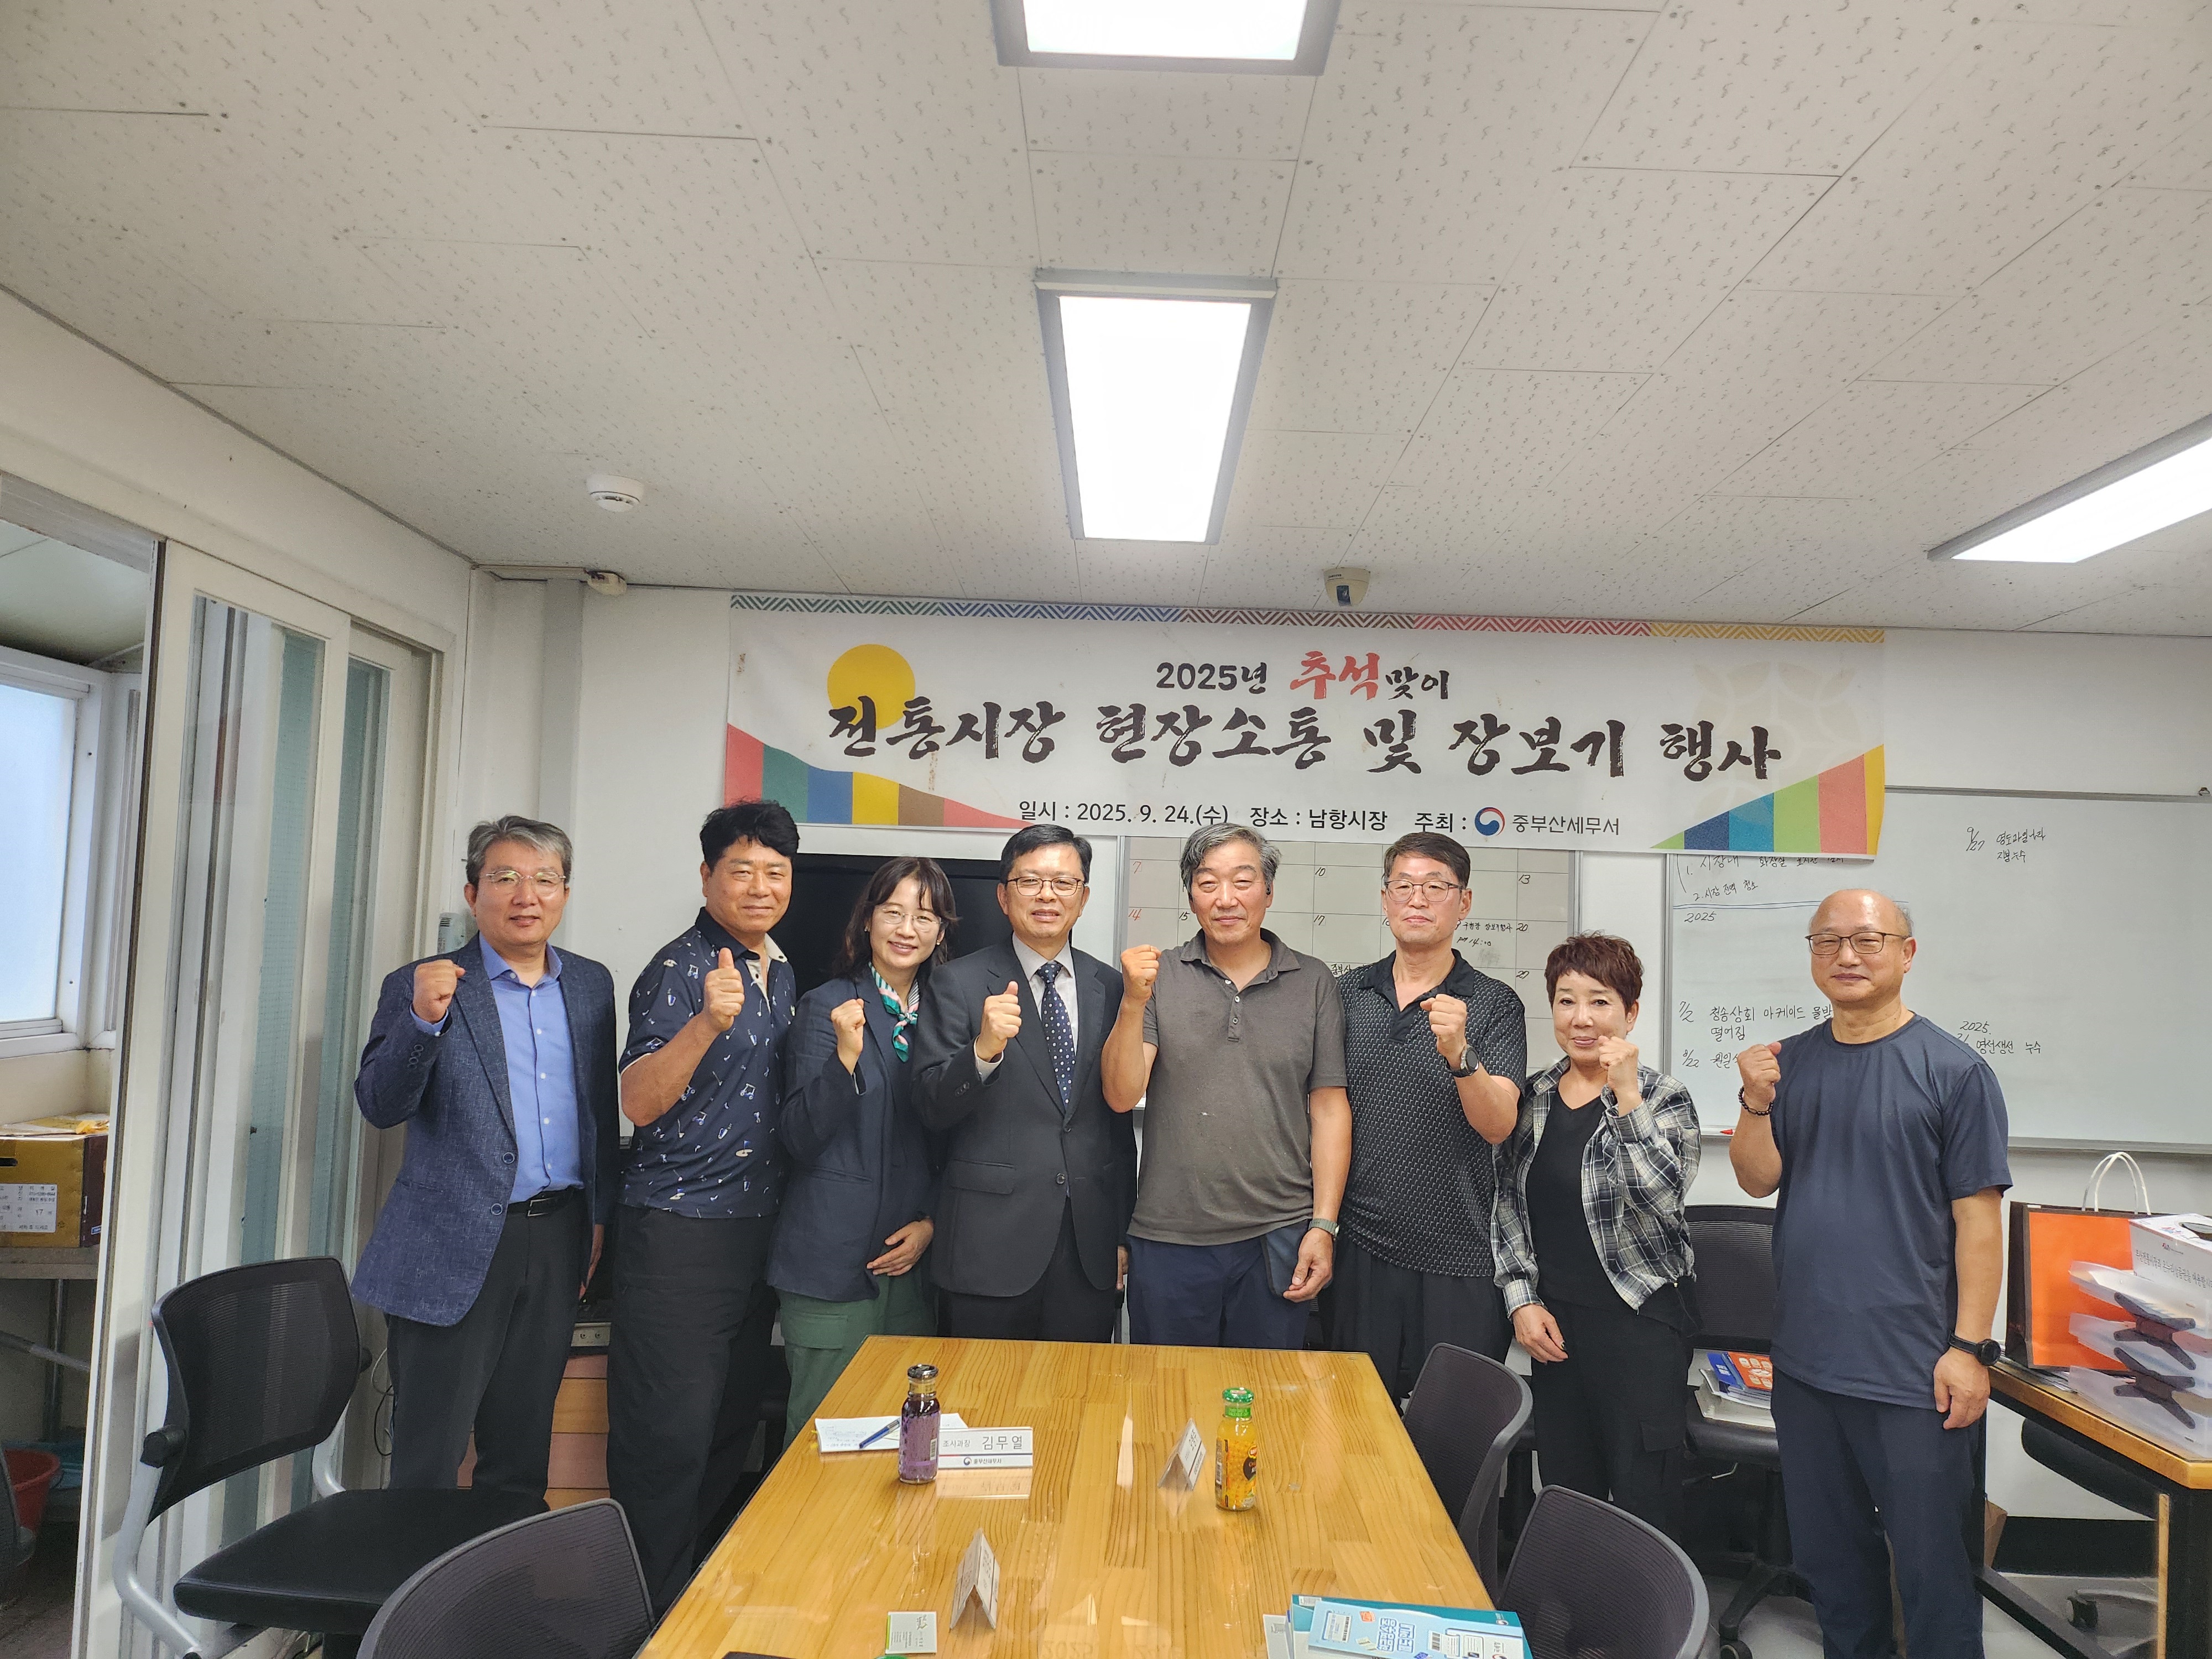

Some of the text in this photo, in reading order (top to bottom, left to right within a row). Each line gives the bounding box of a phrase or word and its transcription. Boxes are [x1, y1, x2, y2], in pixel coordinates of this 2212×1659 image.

[1156, 650, 1450, 700] 2025년 추석맞이
[829, 695, 1782, 781] 전통시장 현장소통 및 장보기 행사
[1019, 801, 1056, 821] 일시
[1077, 803, 1131, 823] 2025.
[1140, 805, 1156, 823] 9.
[1250, 806, 1288, 827] 장소
[1309, 809, 1388, 831] 남항시장
[1414, 812, 1453, 833] 주최
[1511, 815, 1620, 836] 중부산세무서
[1133, 861, 1141, 874] 7
[1314, 867, 1326, 877] 10
[1518, 874, 1531, 884] 13
[1128, 908, 1142, 921] 14
[1178, 911, 1190, 921] 15
[1313, 915, 1325, 926] 17
[1684, 911, 1717, 922] 2025
[1516, 923, 1528, 931] 20
[1515, 971, 1530, 979] 27
[1679, 1001, 1694, 1022] 7/2
[1709, 1005, 1755, 1022] 청송상회
[1764, 1004, 1806, 1019] 아케이드
[1711, 1025, 1745, 1042] 떨어짐
[2025, 1041, 2041, 1055] 누수
[982, 1435, 1022, 1450] 김무열
